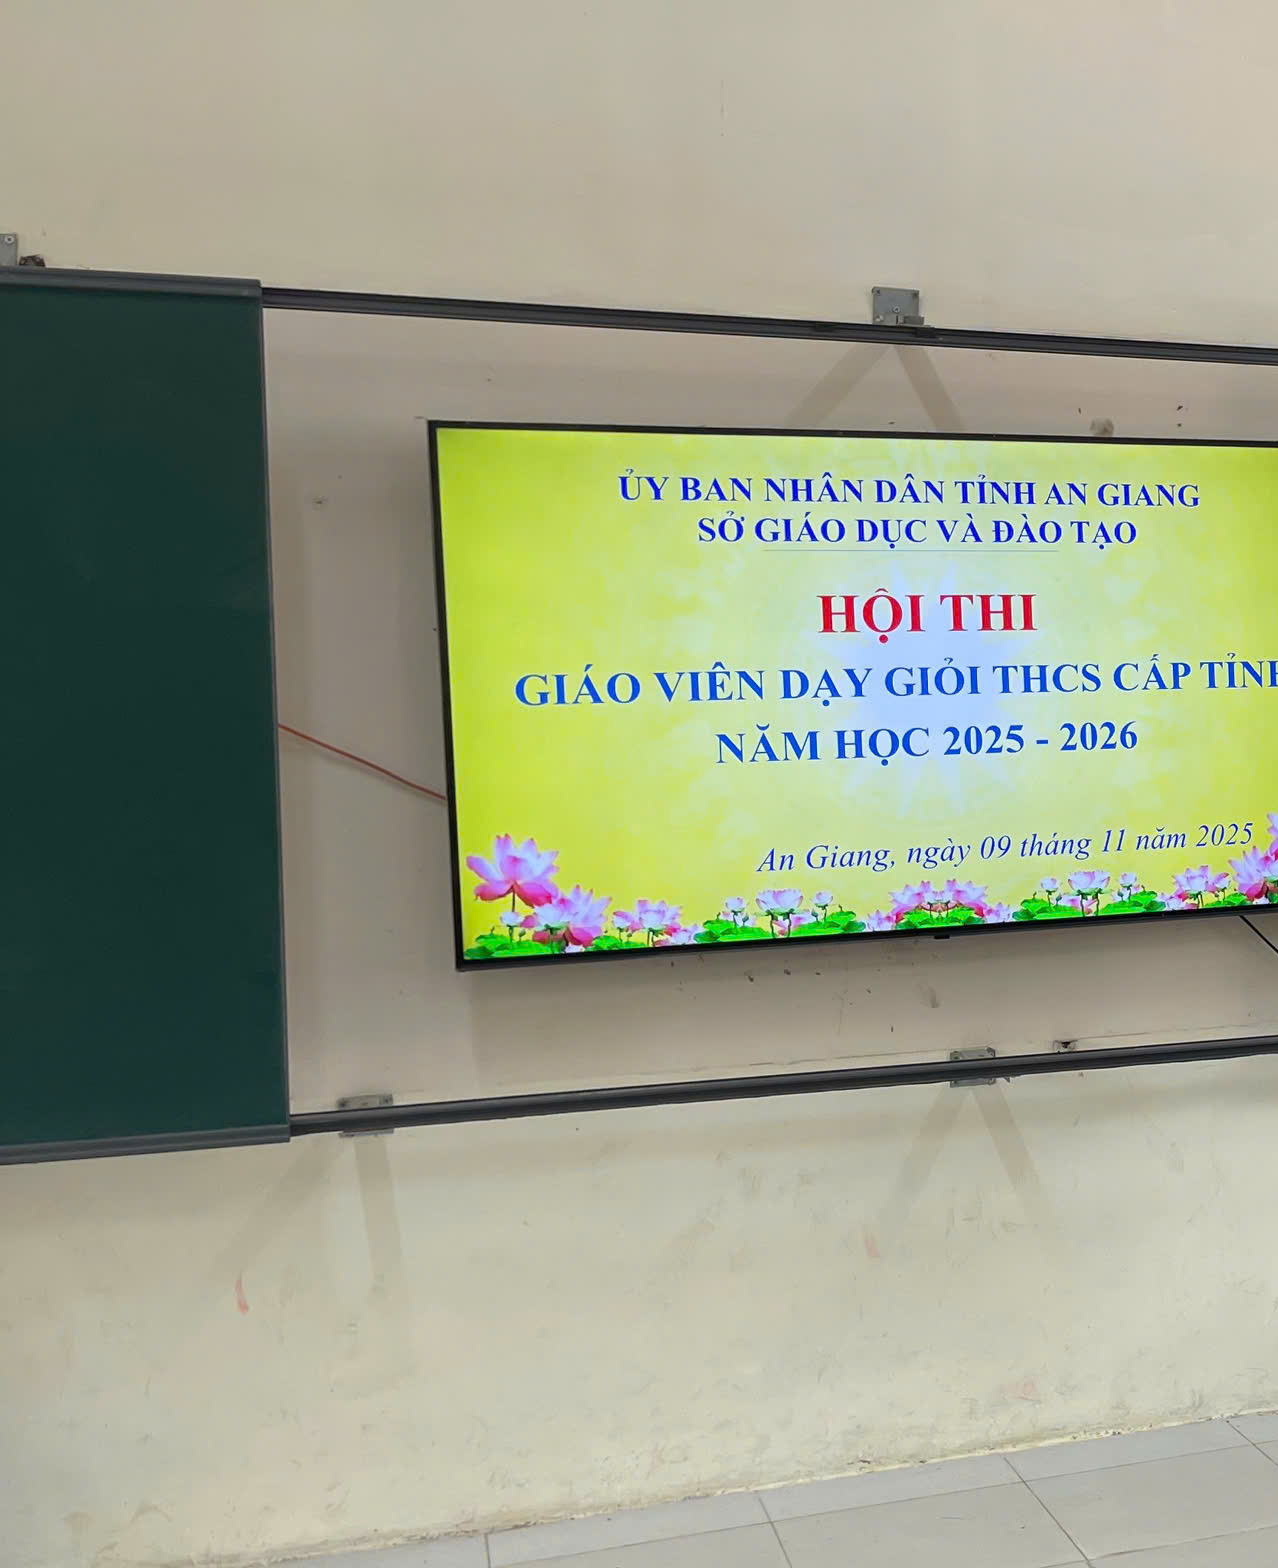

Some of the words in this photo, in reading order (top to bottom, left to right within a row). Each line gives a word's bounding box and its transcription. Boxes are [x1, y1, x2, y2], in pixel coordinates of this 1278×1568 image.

[619, 469, 668, 500] ỦY
[680, 477, 752, 501] BAN
[764, 472, 863, 502] NHÂN
[874, 473, 944, 503] DÂN
[955, 475, 1036, 504] TỈNH
[1044, 483, 1087, 505] AN
[1098, 484, 1199, 507] GIANG
[699, 511, 744, 541] SỞ
[755, 512, 845, 542] GIÁO
[856, 520, 926, 549] DỤC
[936, 513, 983, 542] VÀ
[993, 514, 1062, 543] ĐÀO
[1070, 521, 1136, 549] TẠO
[819, 588, 925, 643] HỘI
[938, 594, 1037, 631] THI
[516, 664, 640, 705] GIÁO
[654, 662, 764, 702] VIÊN
[780, 668, 872, 706] DẠY
[885, 658, 980, 696] GIỎI
[993, 664, 1101, 693] THCS
[1114, 654, 1190, 691] CẤP
[716, 724, 819, 763] NĂM
[835, 728, 929, 766] HỌC
[944, 725, 1024, 755] 2025
[1060, 721, 1137, 750] 2026
[757, 848, 793, 871] An
[807, 845, 894, 871] Giang,
[908, 838, 970, 869] ngày
[981, 836, 1011, 859] 09
[1021, 833, 1091, 860] tháng
[1103, 830, 1124, 852] 11
[1136, 828, 1185, 850] năm
[1196, 823, 1252, 846] 2025
